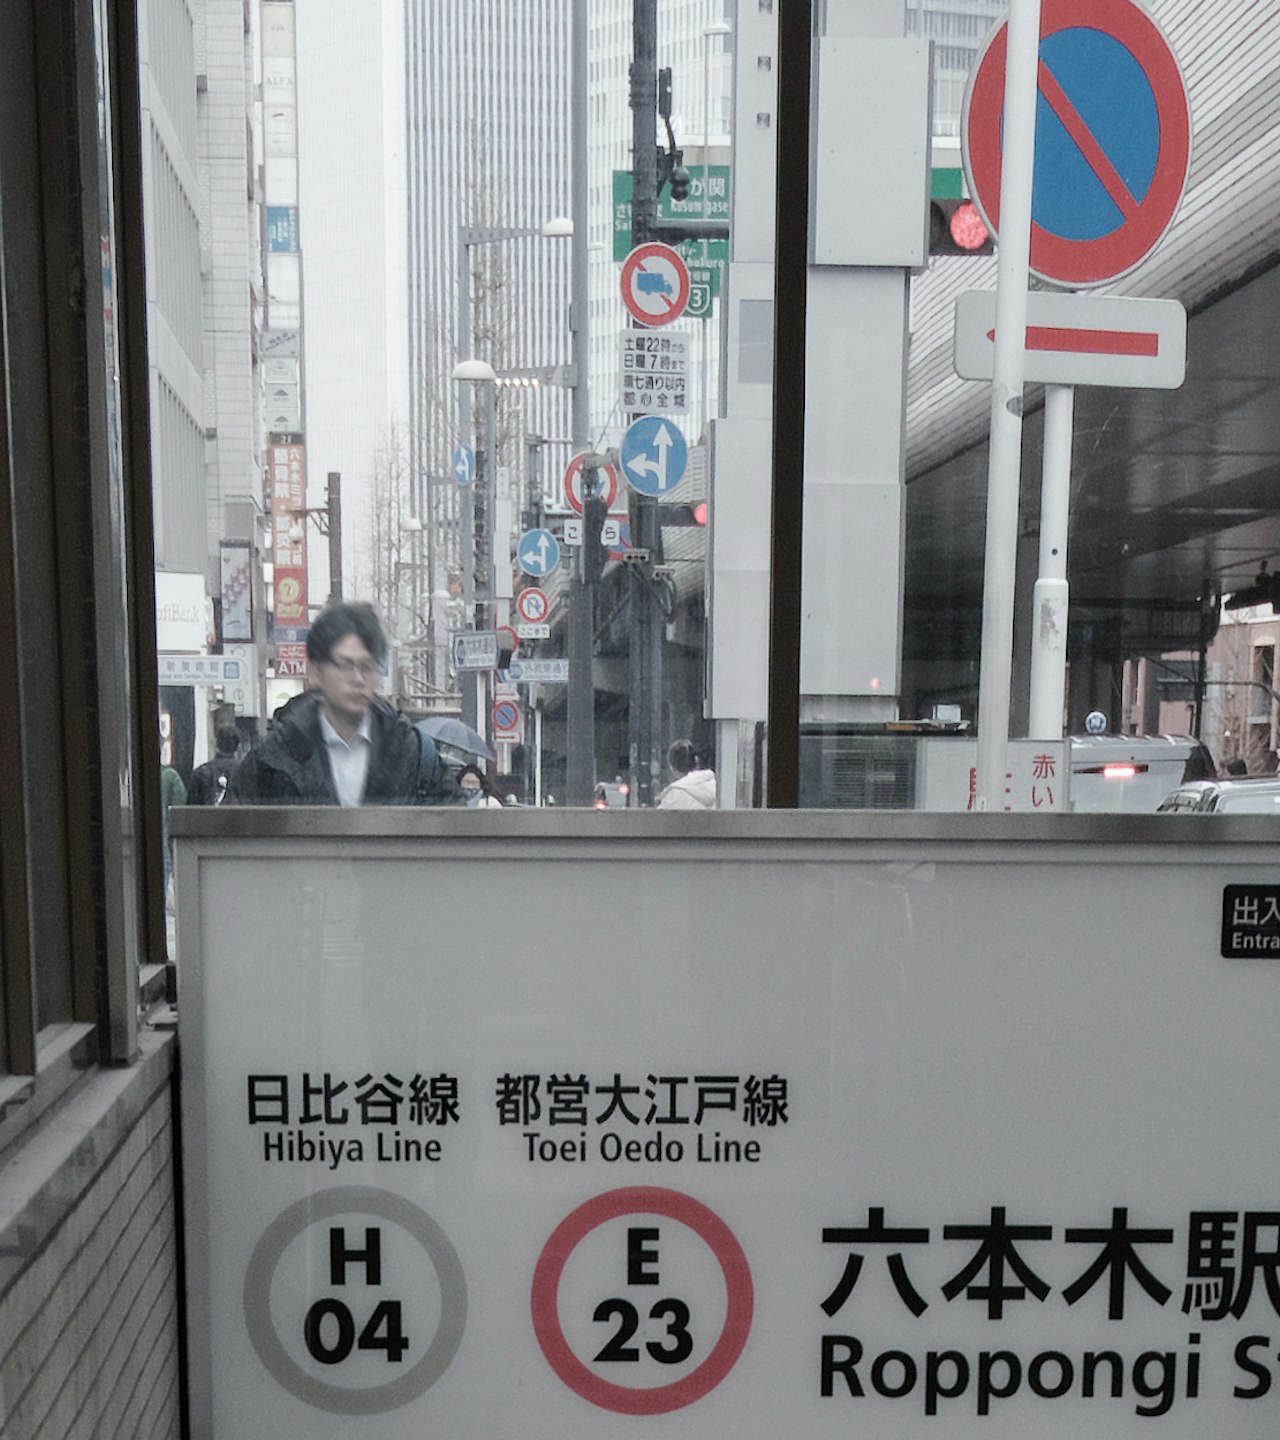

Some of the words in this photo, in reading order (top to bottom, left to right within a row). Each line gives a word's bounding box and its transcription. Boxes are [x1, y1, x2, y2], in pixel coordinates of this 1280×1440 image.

[692, 289, 703, 307] 3
[278, 660, 306, 676] ATM
[246, 1071, 461, 1127] 日比谷線
[495, 1071, 790, 1127] 都営大江戸線
[262, 1129, 363, 1170] Hibiya
[377, 1129, 443, 1162] Line
[522, 1130, 587, 1163] Toei
[600, 1130, 684, 1163] Oedo
[697, 1130, 762, 1163] Line
[328, 1226, 383, 1287] H
[626, 1226, 661, 1287] E
[302, 1296, 411, 1366] 04
[591, 1296, 696, 1366] 23
[820, 1331, 1202, 1419] Roppongi
